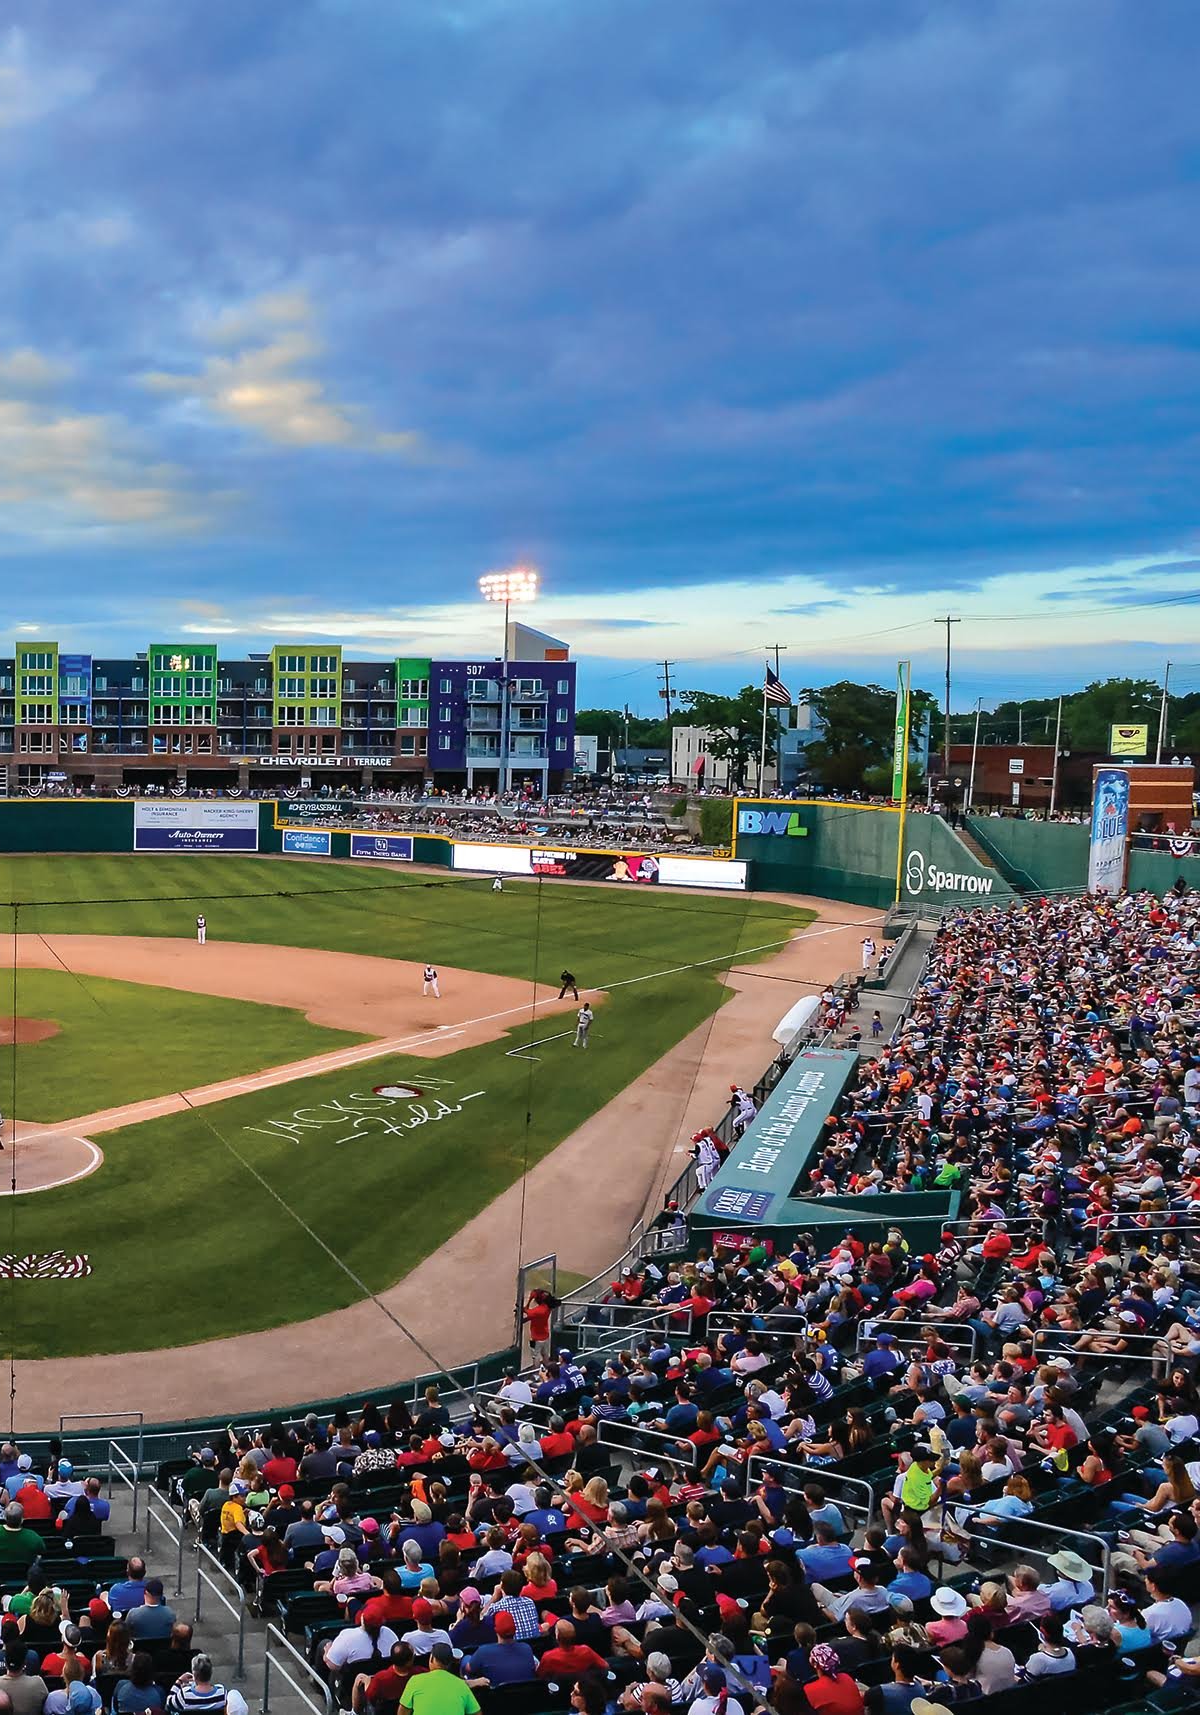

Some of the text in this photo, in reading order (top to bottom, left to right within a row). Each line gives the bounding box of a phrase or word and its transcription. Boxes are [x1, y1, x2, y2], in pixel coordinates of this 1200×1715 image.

[466, 665, 486, 676] 507'
[260, 757, 391, 766] CHEVROLET TERRACE
[738, 811, 807, 836] BWL
[168, 830, 224, 839] Auto-Owners
[286, 833, 328, 844] Confidence.
[927, 865, 993, 895] Sparrow
[354, 1100, 462, 1136] Field
[770, 1098, 818, 1122] Lansing
[761, 1118, 795, 1137] the
[756, 1134, 787, 1148] of
[737, 1146, 781, 1174] Home
[713, 1188, 742, 1212] COOLEY
